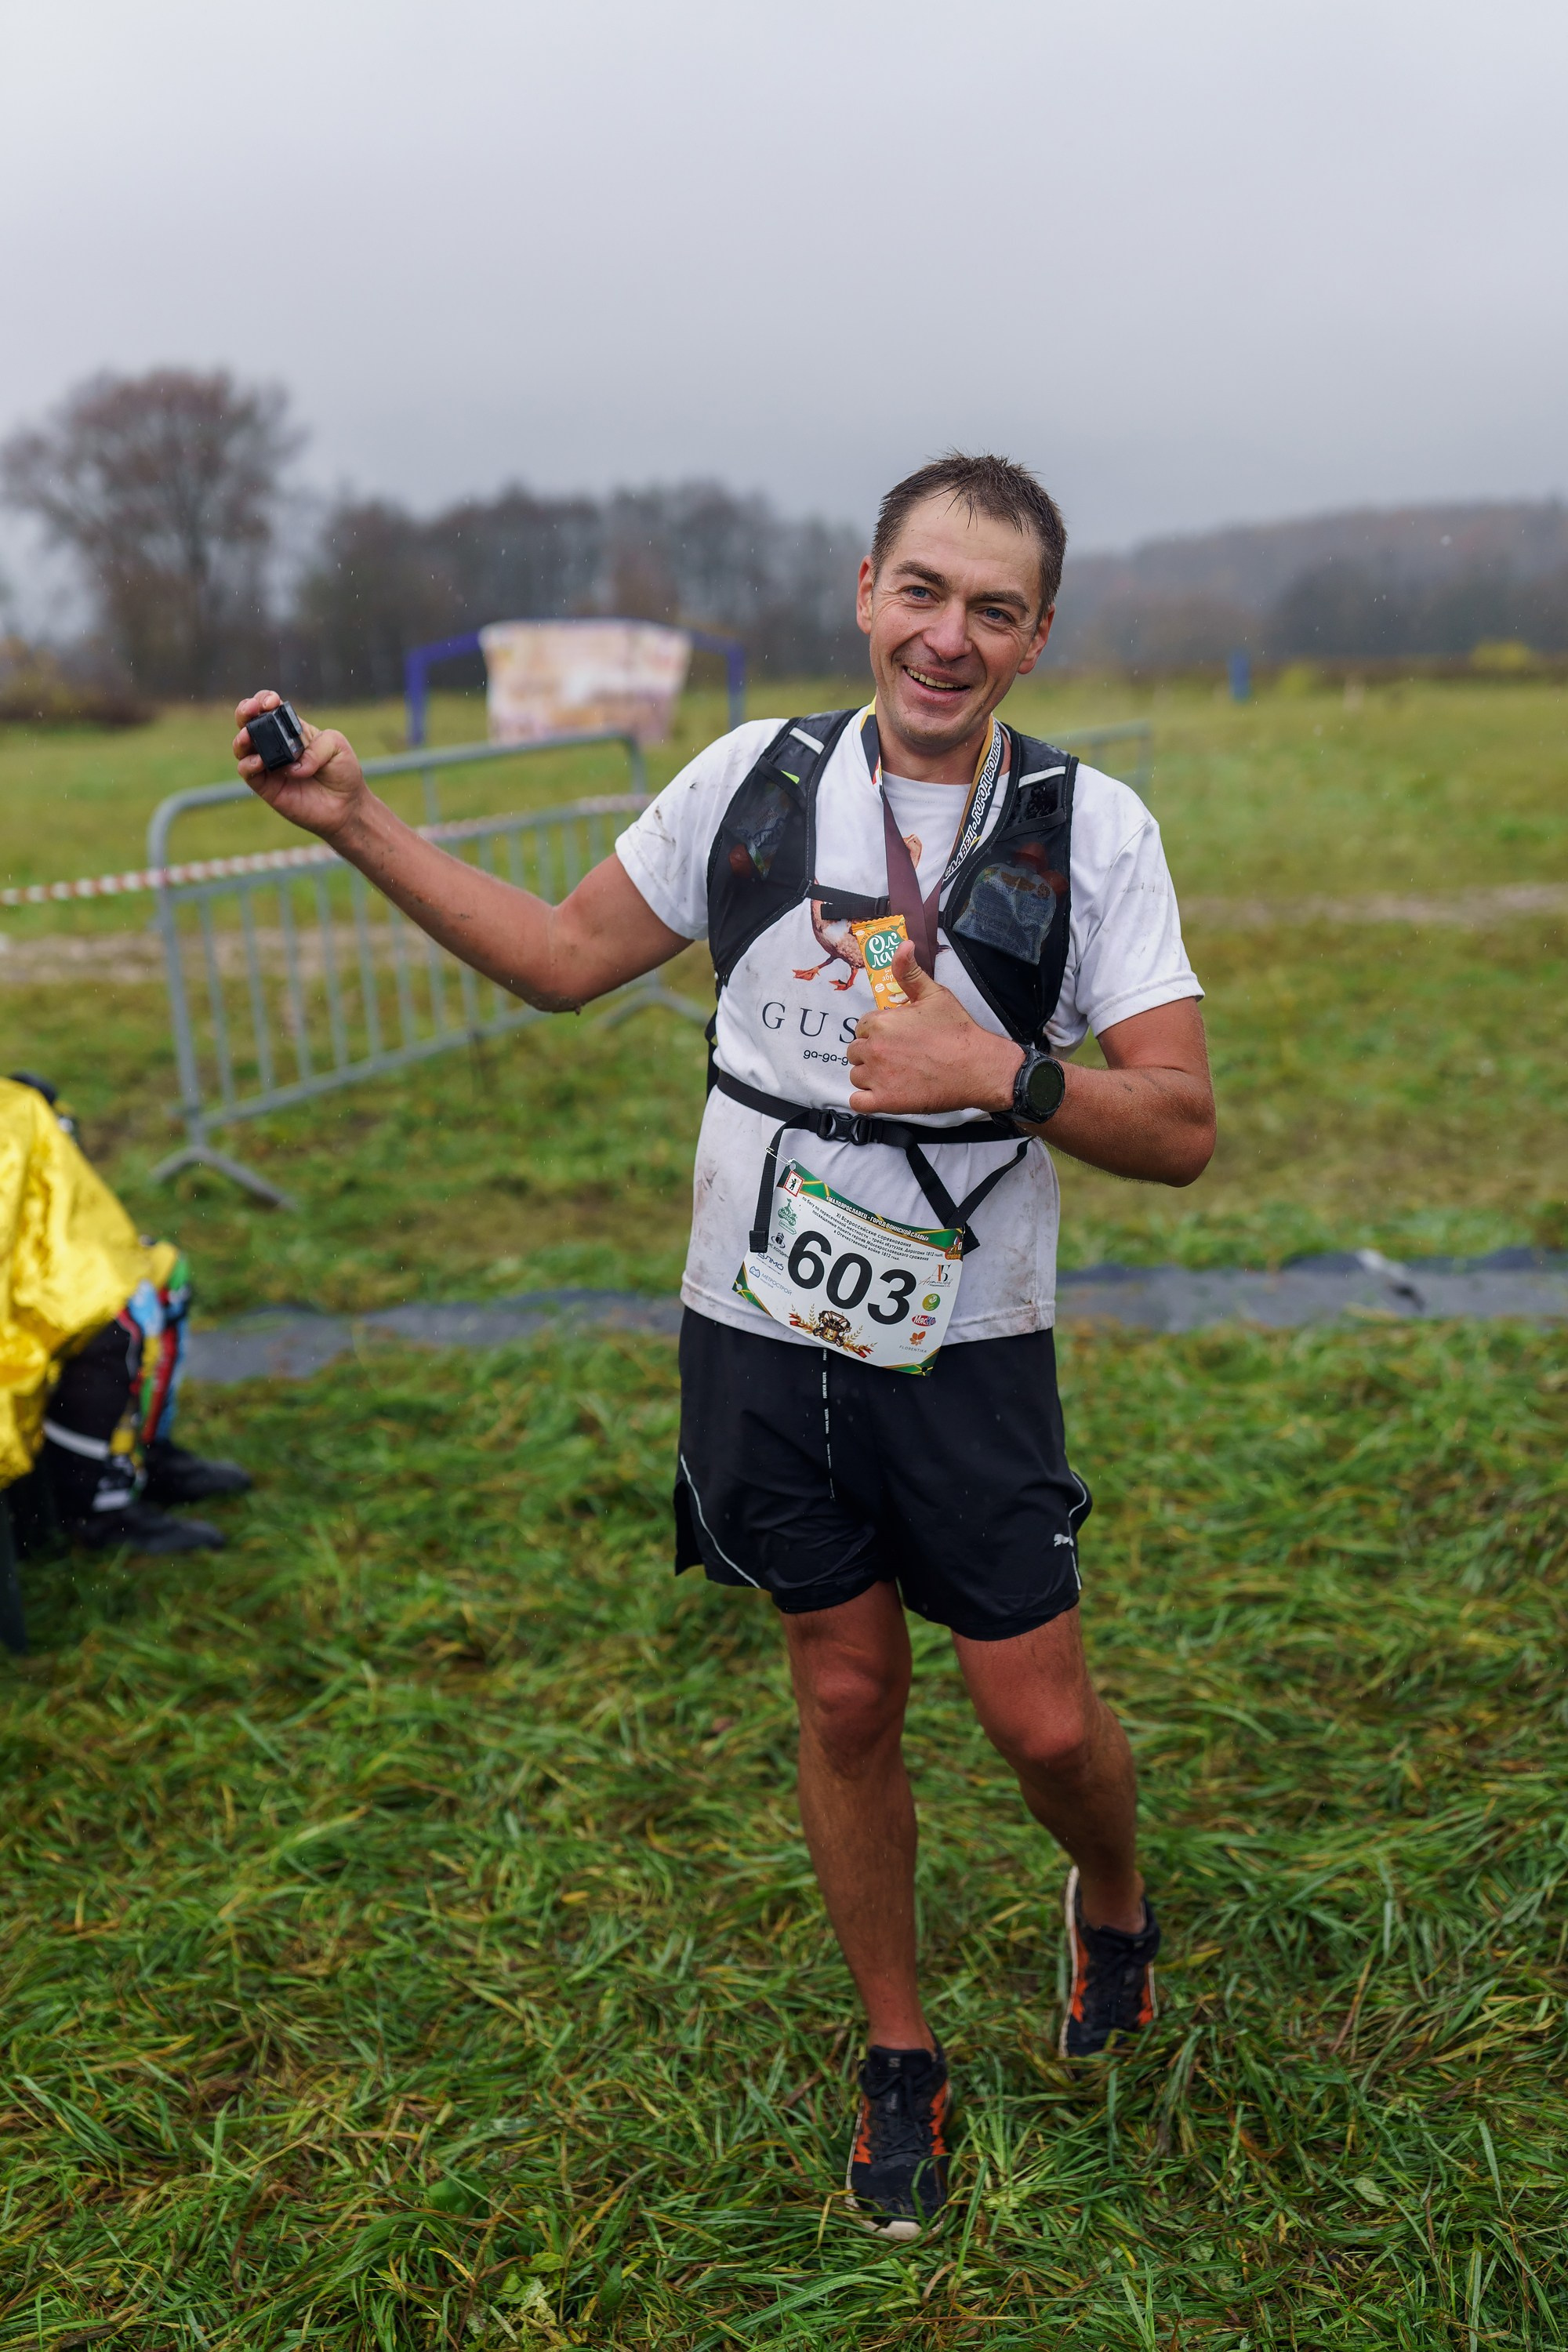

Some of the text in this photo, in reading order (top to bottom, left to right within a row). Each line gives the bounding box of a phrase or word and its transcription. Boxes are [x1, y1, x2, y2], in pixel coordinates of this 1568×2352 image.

[943, 825, 977, 882] СЛАВЕЦ
[971, 775, 993, 824] ГОРОД
[882, 973, 894, 982] абр
[762, 1002, 859, 1044] GUS
[803, 1050, 849, 1065] ga-ga-g
[806, 1199, 815, 1207] бегу
[819, 1208, 846, 1227] пересеченной
[847, 1225, 869, 1239] местности
[841, 1216, 877, 1236] Всероссийские
[877, 1234, 911, 1247] соревнования
[869, 1217, 886, 1228] ГОРОД
[885, 1222, 911, 1236] ВОИНСКОЙ
[812, 1210, 837, 1228] посвященные
[837, 1226, 851, 1236] памяти
[851, 1233, 866, 1243] героев
[866, 1240, 909, 1258] Малоярославецкого
[837, 1231, 868, 1249] Отечественной
[761, 1273, 793, 1296] МЕТРОСТРОЙ
[787, 1230, 916, 1325] 603
[898, 1345, 927, 1353] FLORENTIKA
